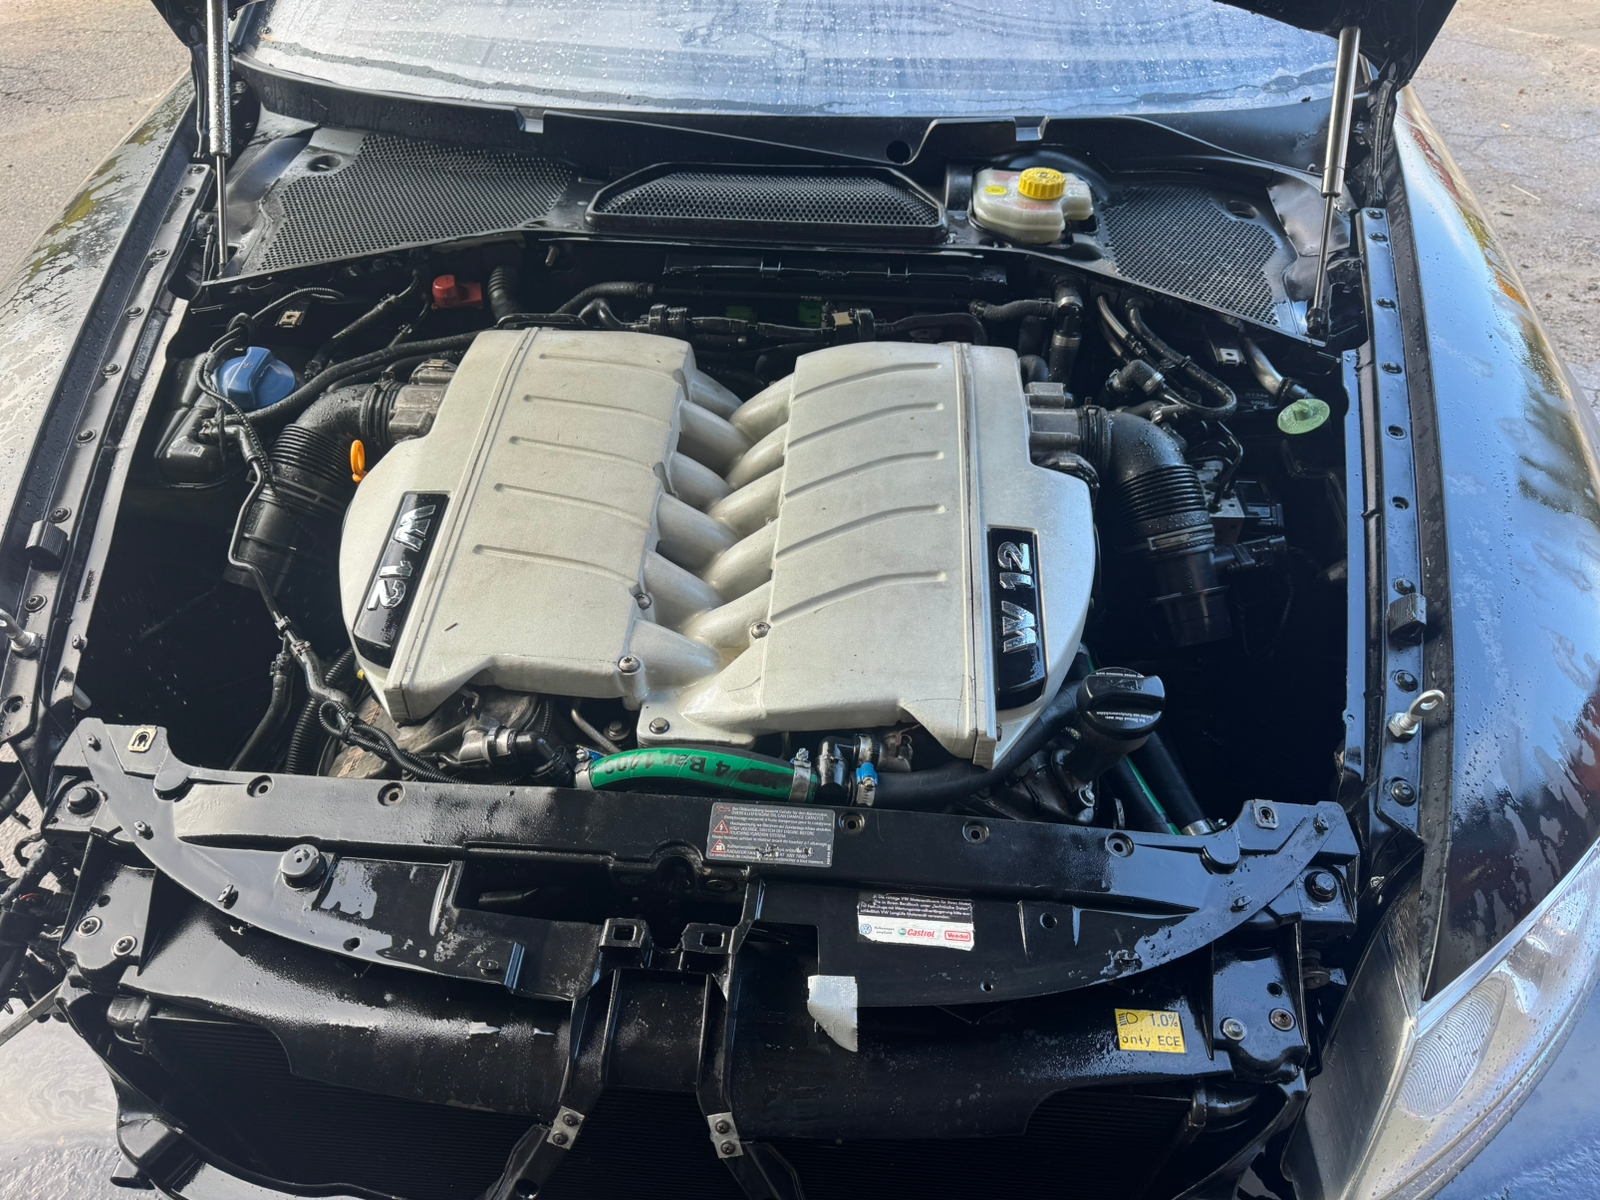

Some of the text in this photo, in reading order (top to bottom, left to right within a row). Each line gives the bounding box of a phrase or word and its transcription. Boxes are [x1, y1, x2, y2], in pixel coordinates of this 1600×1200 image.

[663, 754, 706, 774] Bar
[714, 760, 731, 777] 4
[908, 929, 935, 938] Castrol
[1151, 1014, 1178, 1027] 1.0%
[1122, 1035, 1181, 1047] only ECE
